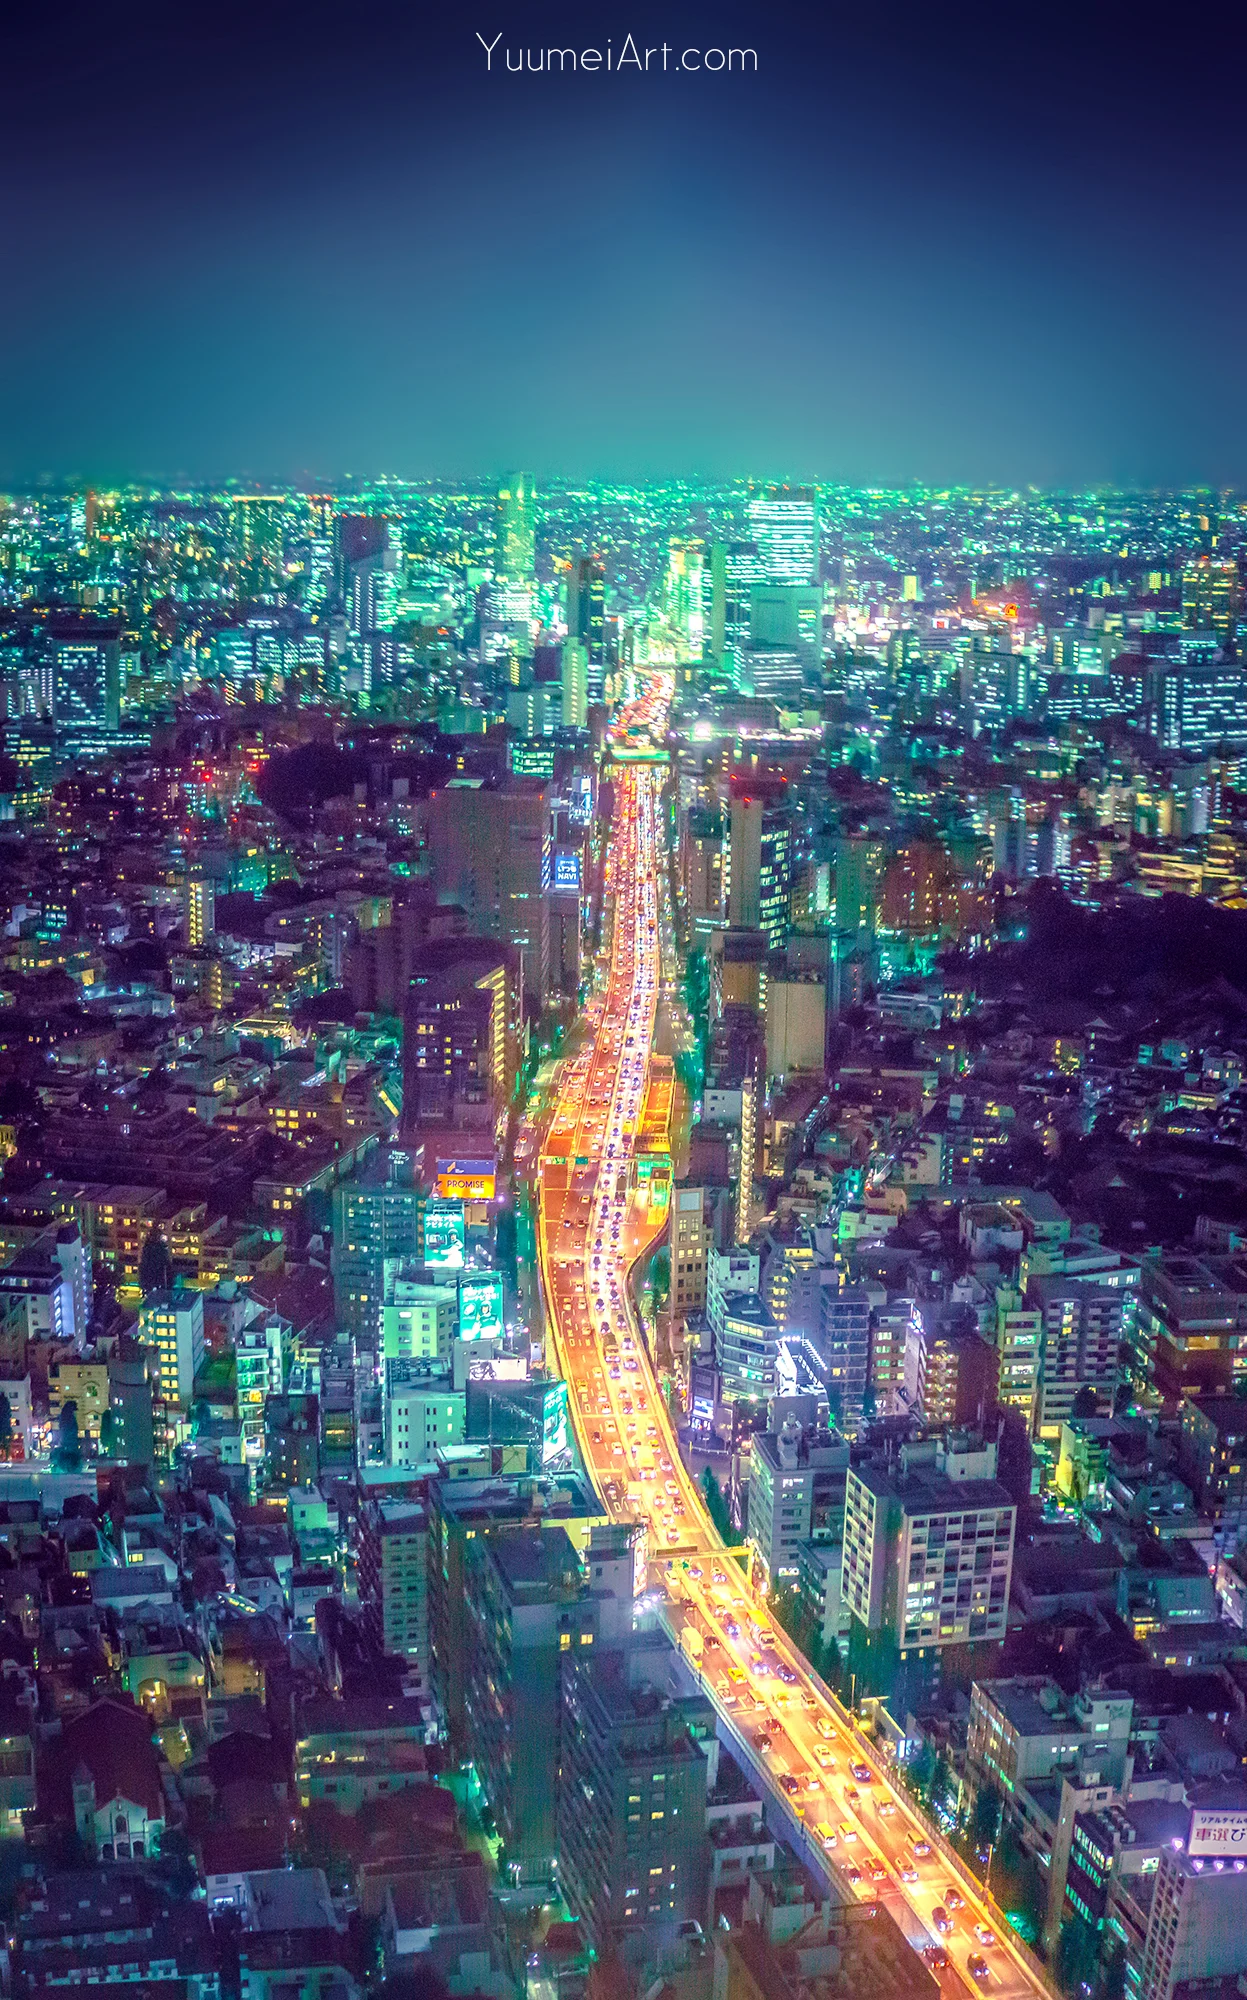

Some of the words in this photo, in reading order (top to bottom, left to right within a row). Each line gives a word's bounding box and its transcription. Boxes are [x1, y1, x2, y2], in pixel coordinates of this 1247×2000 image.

[447, 1180, 485, 1188] PROMISE
[1195, 1828, 1247, 1842] 車選び
